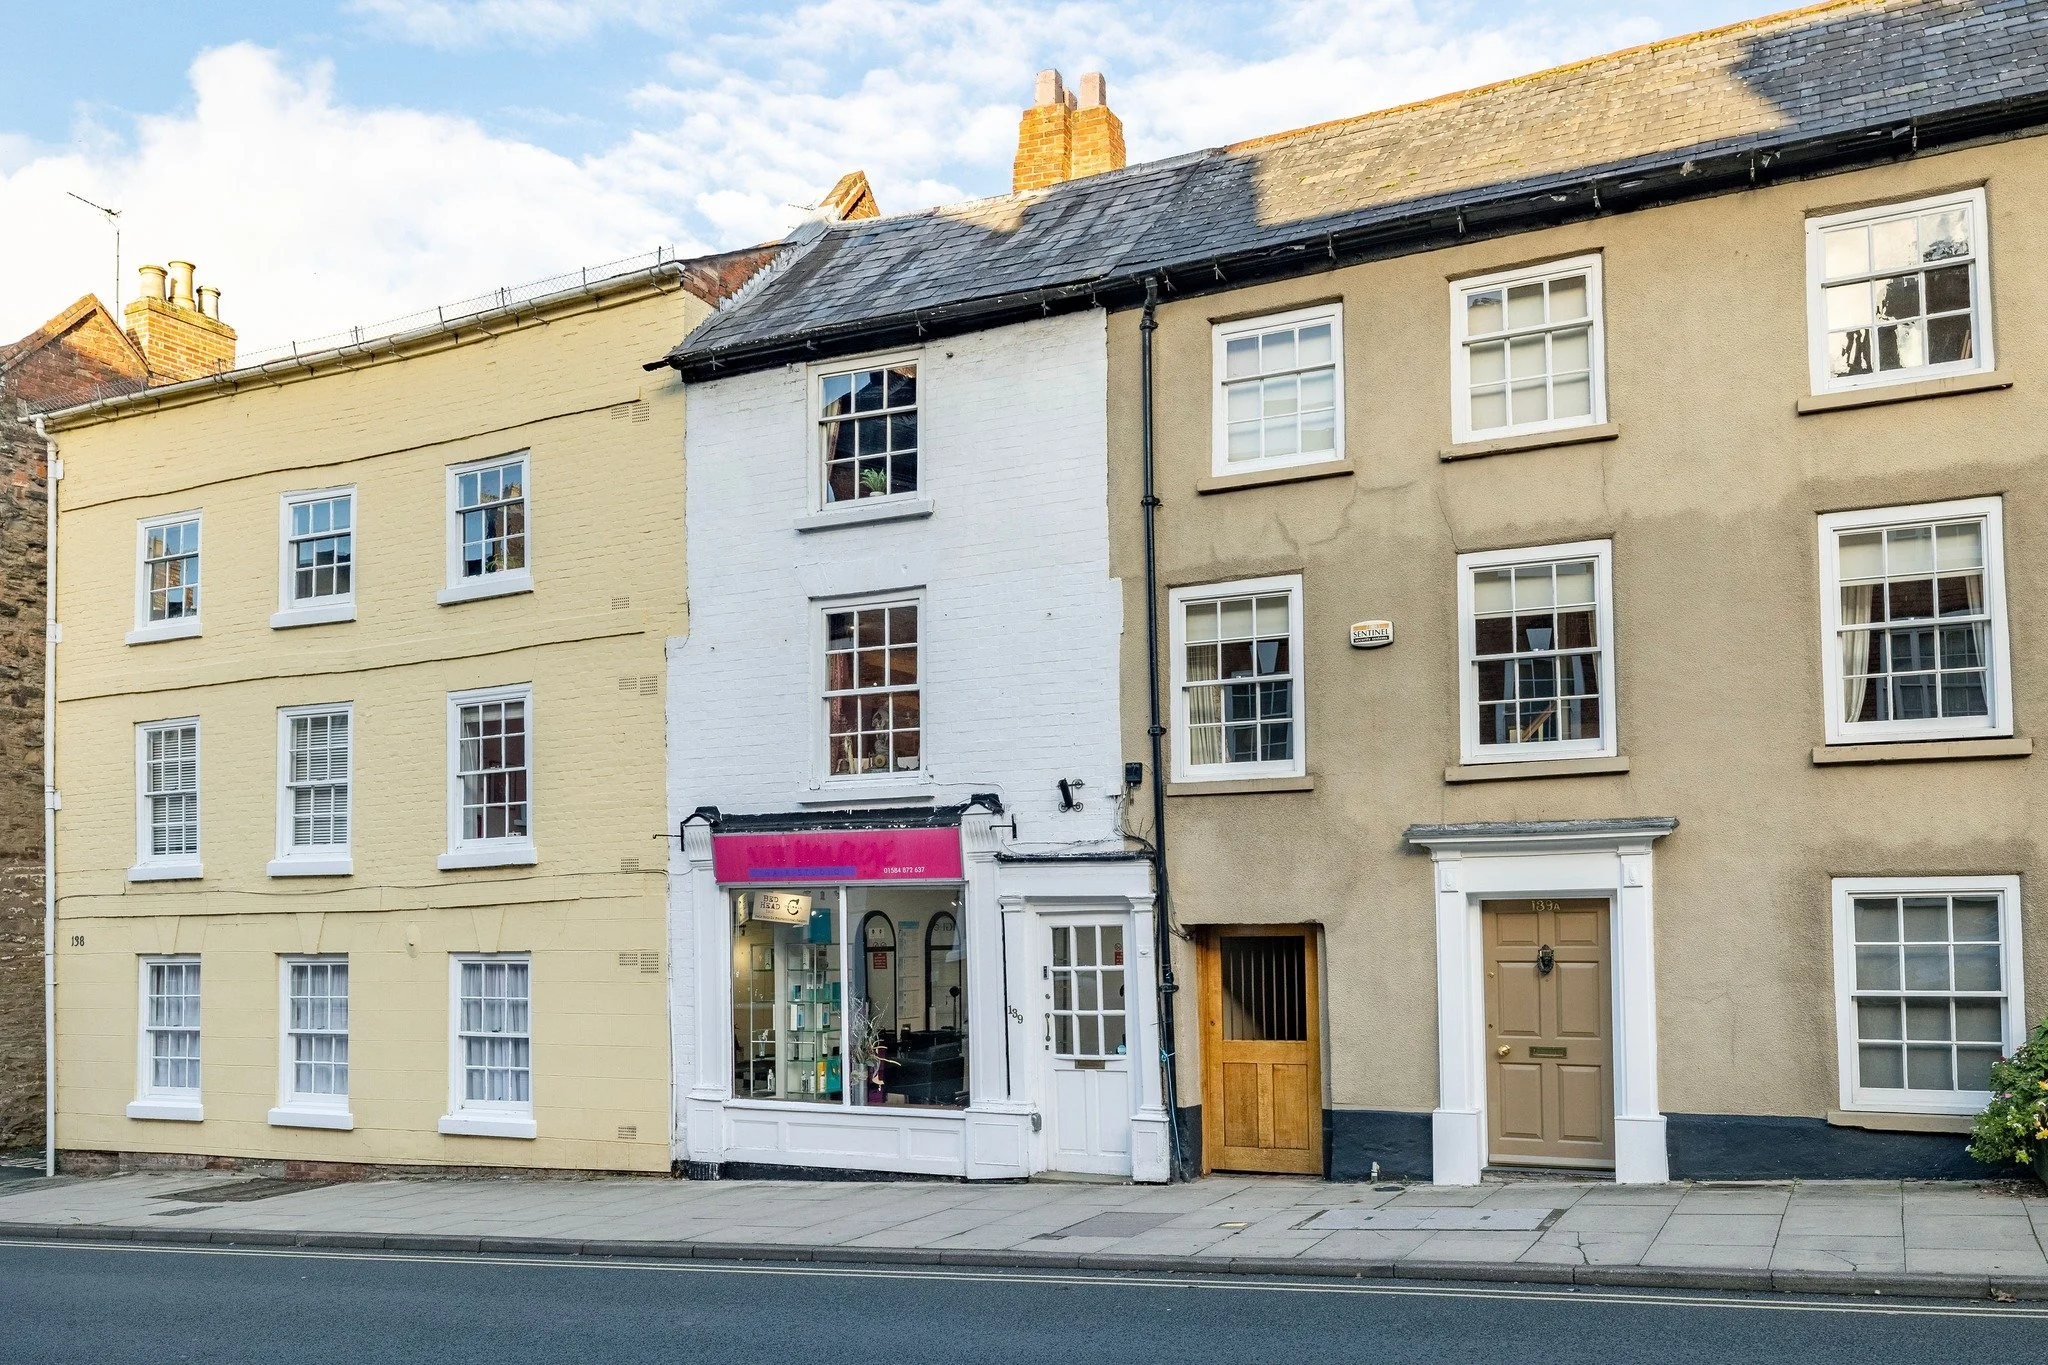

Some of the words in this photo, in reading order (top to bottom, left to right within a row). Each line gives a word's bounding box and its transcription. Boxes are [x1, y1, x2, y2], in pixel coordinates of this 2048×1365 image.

[1353, 629, 1388, 637] SENTINEL
[763, 895, 779, 903] BED
[760, 902, 781, 910] HEAD
[1531, 900, 1560, 911] 139A
[71, 935, 85, 947] 138
[1008, 1005, 1023, 1024] 139
